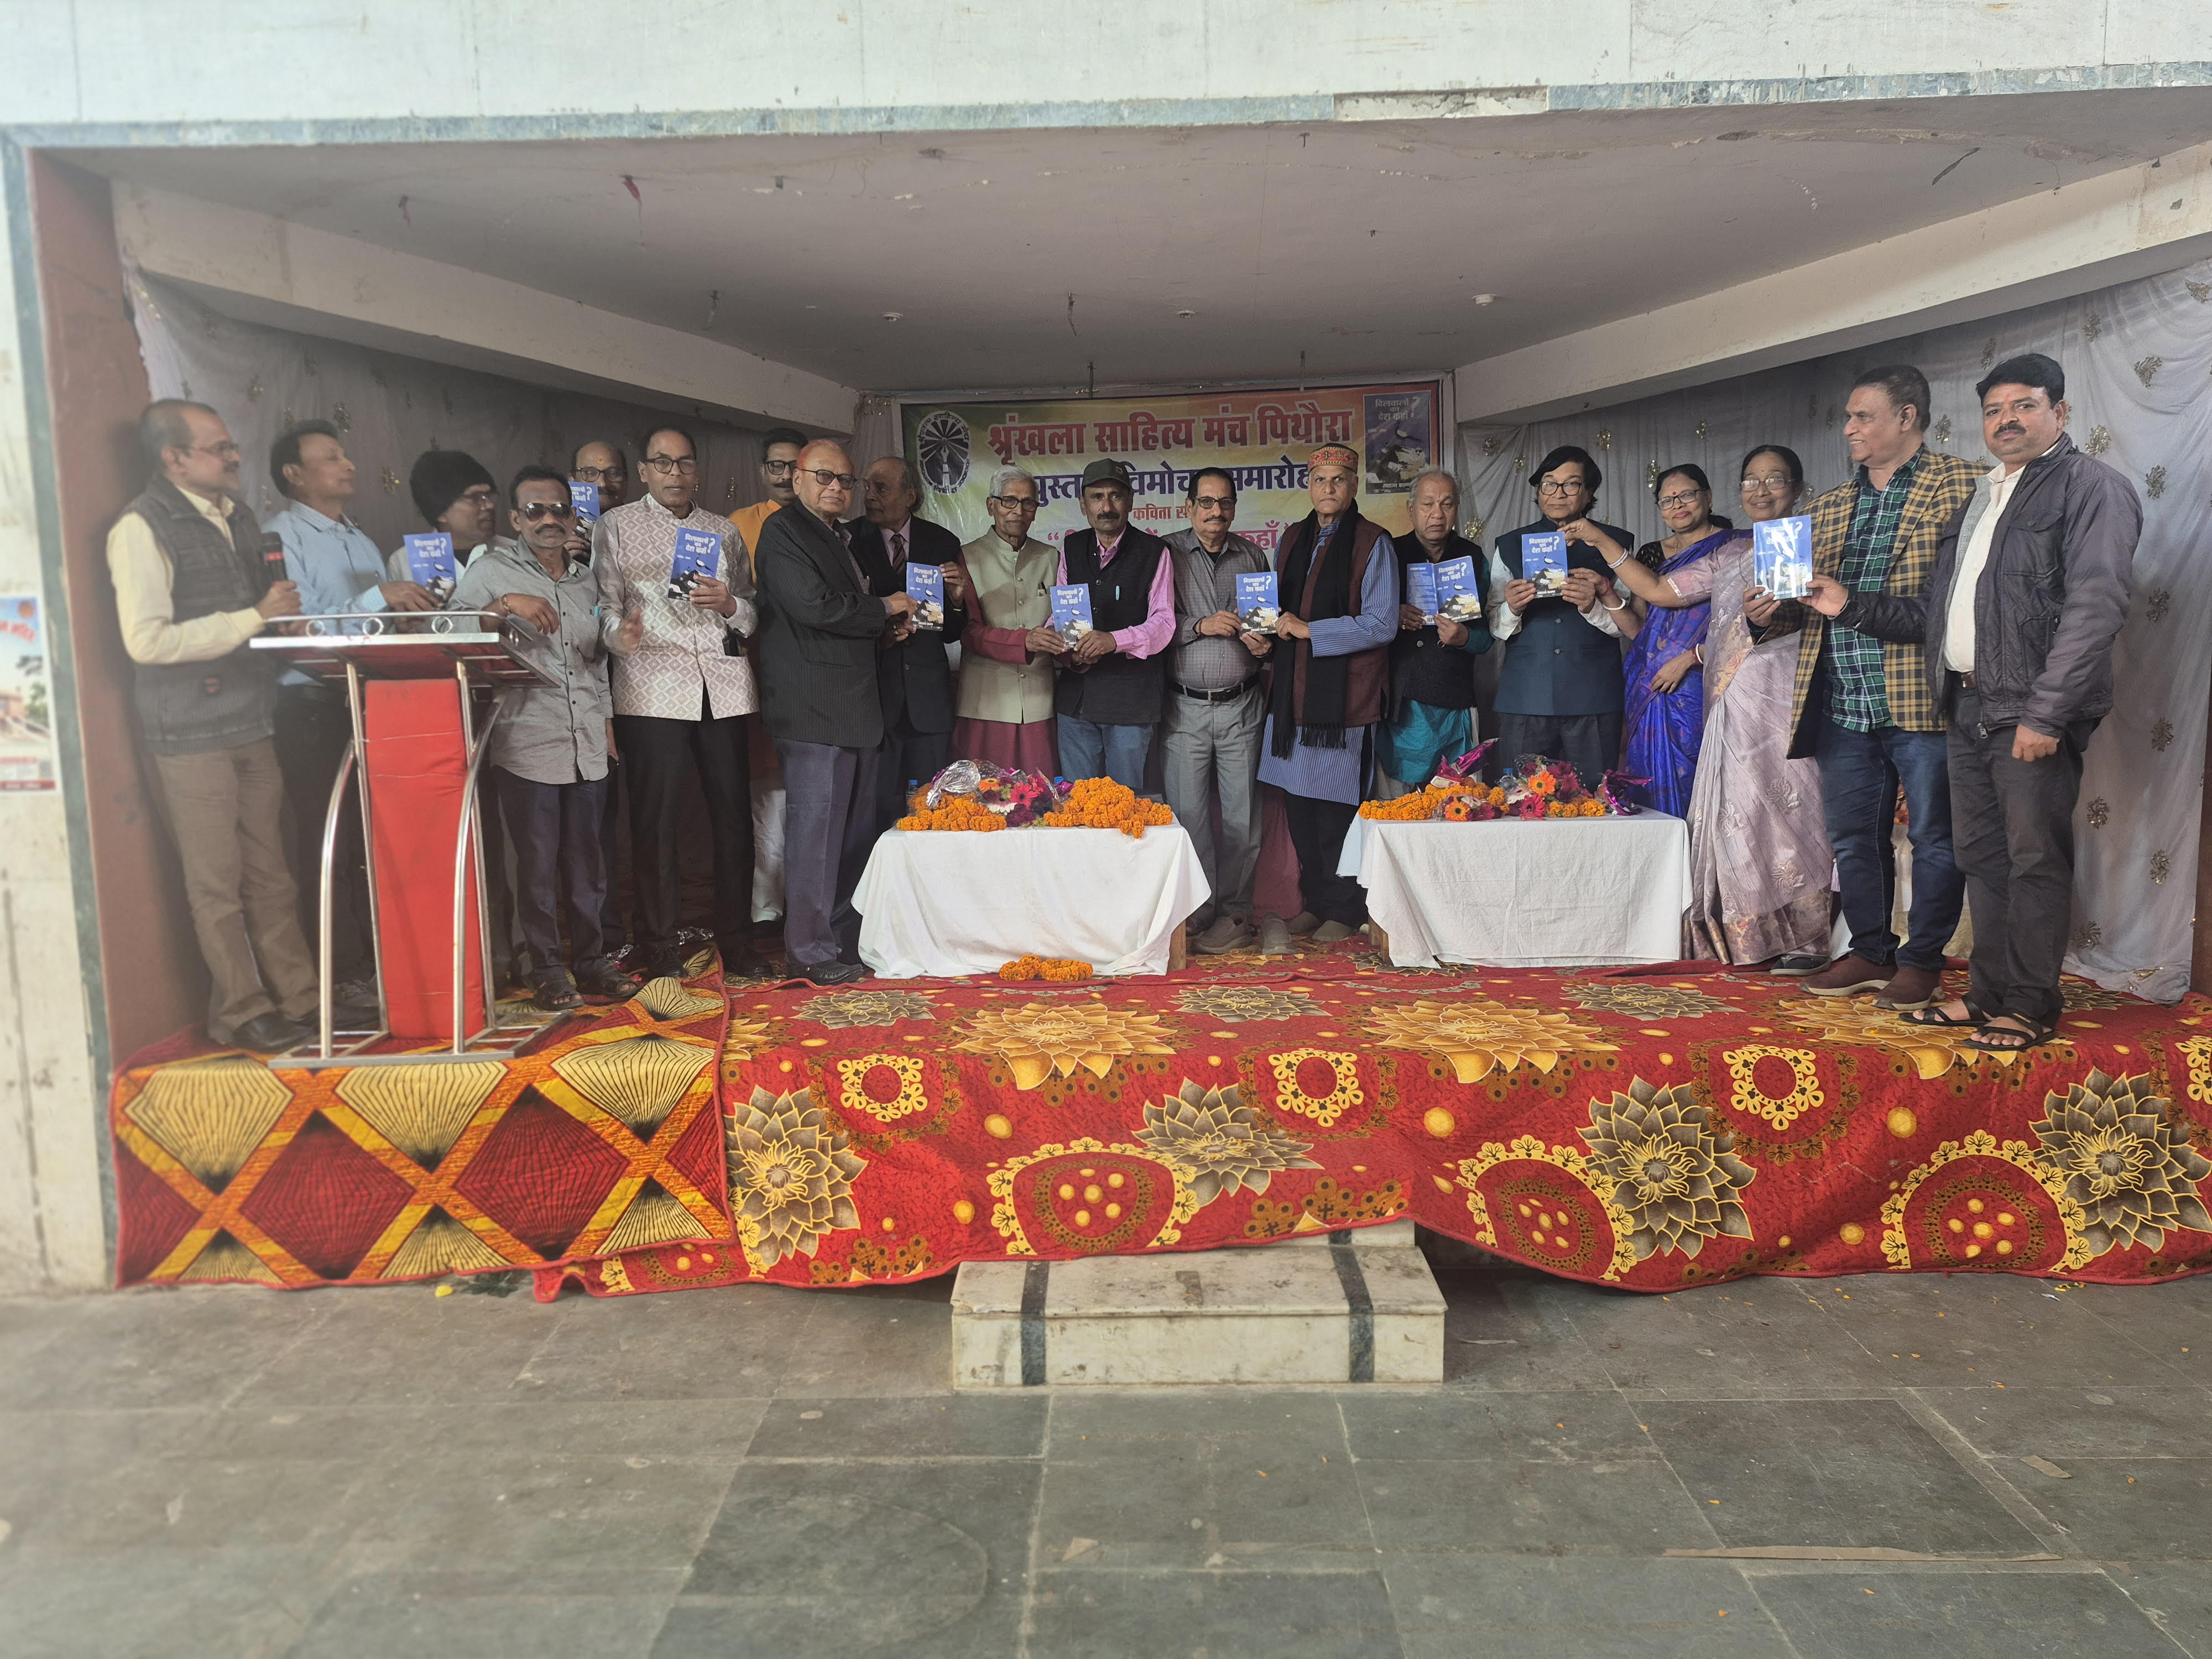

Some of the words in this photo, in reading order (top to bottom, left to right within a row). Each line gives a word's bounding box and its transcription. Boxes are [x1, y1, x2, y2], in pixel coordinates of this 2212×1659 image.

[1094, 411, 1194, 452] साहित्य
[1203, 404, 1250, 447] मंच
[1258, 401, 1353, 446] पिथौरा
[1034, 474, 1096, 507] पुस्त
[1120, 460, 1201, 495] विमोच
[1133, 503, 1172, 520] कविता
